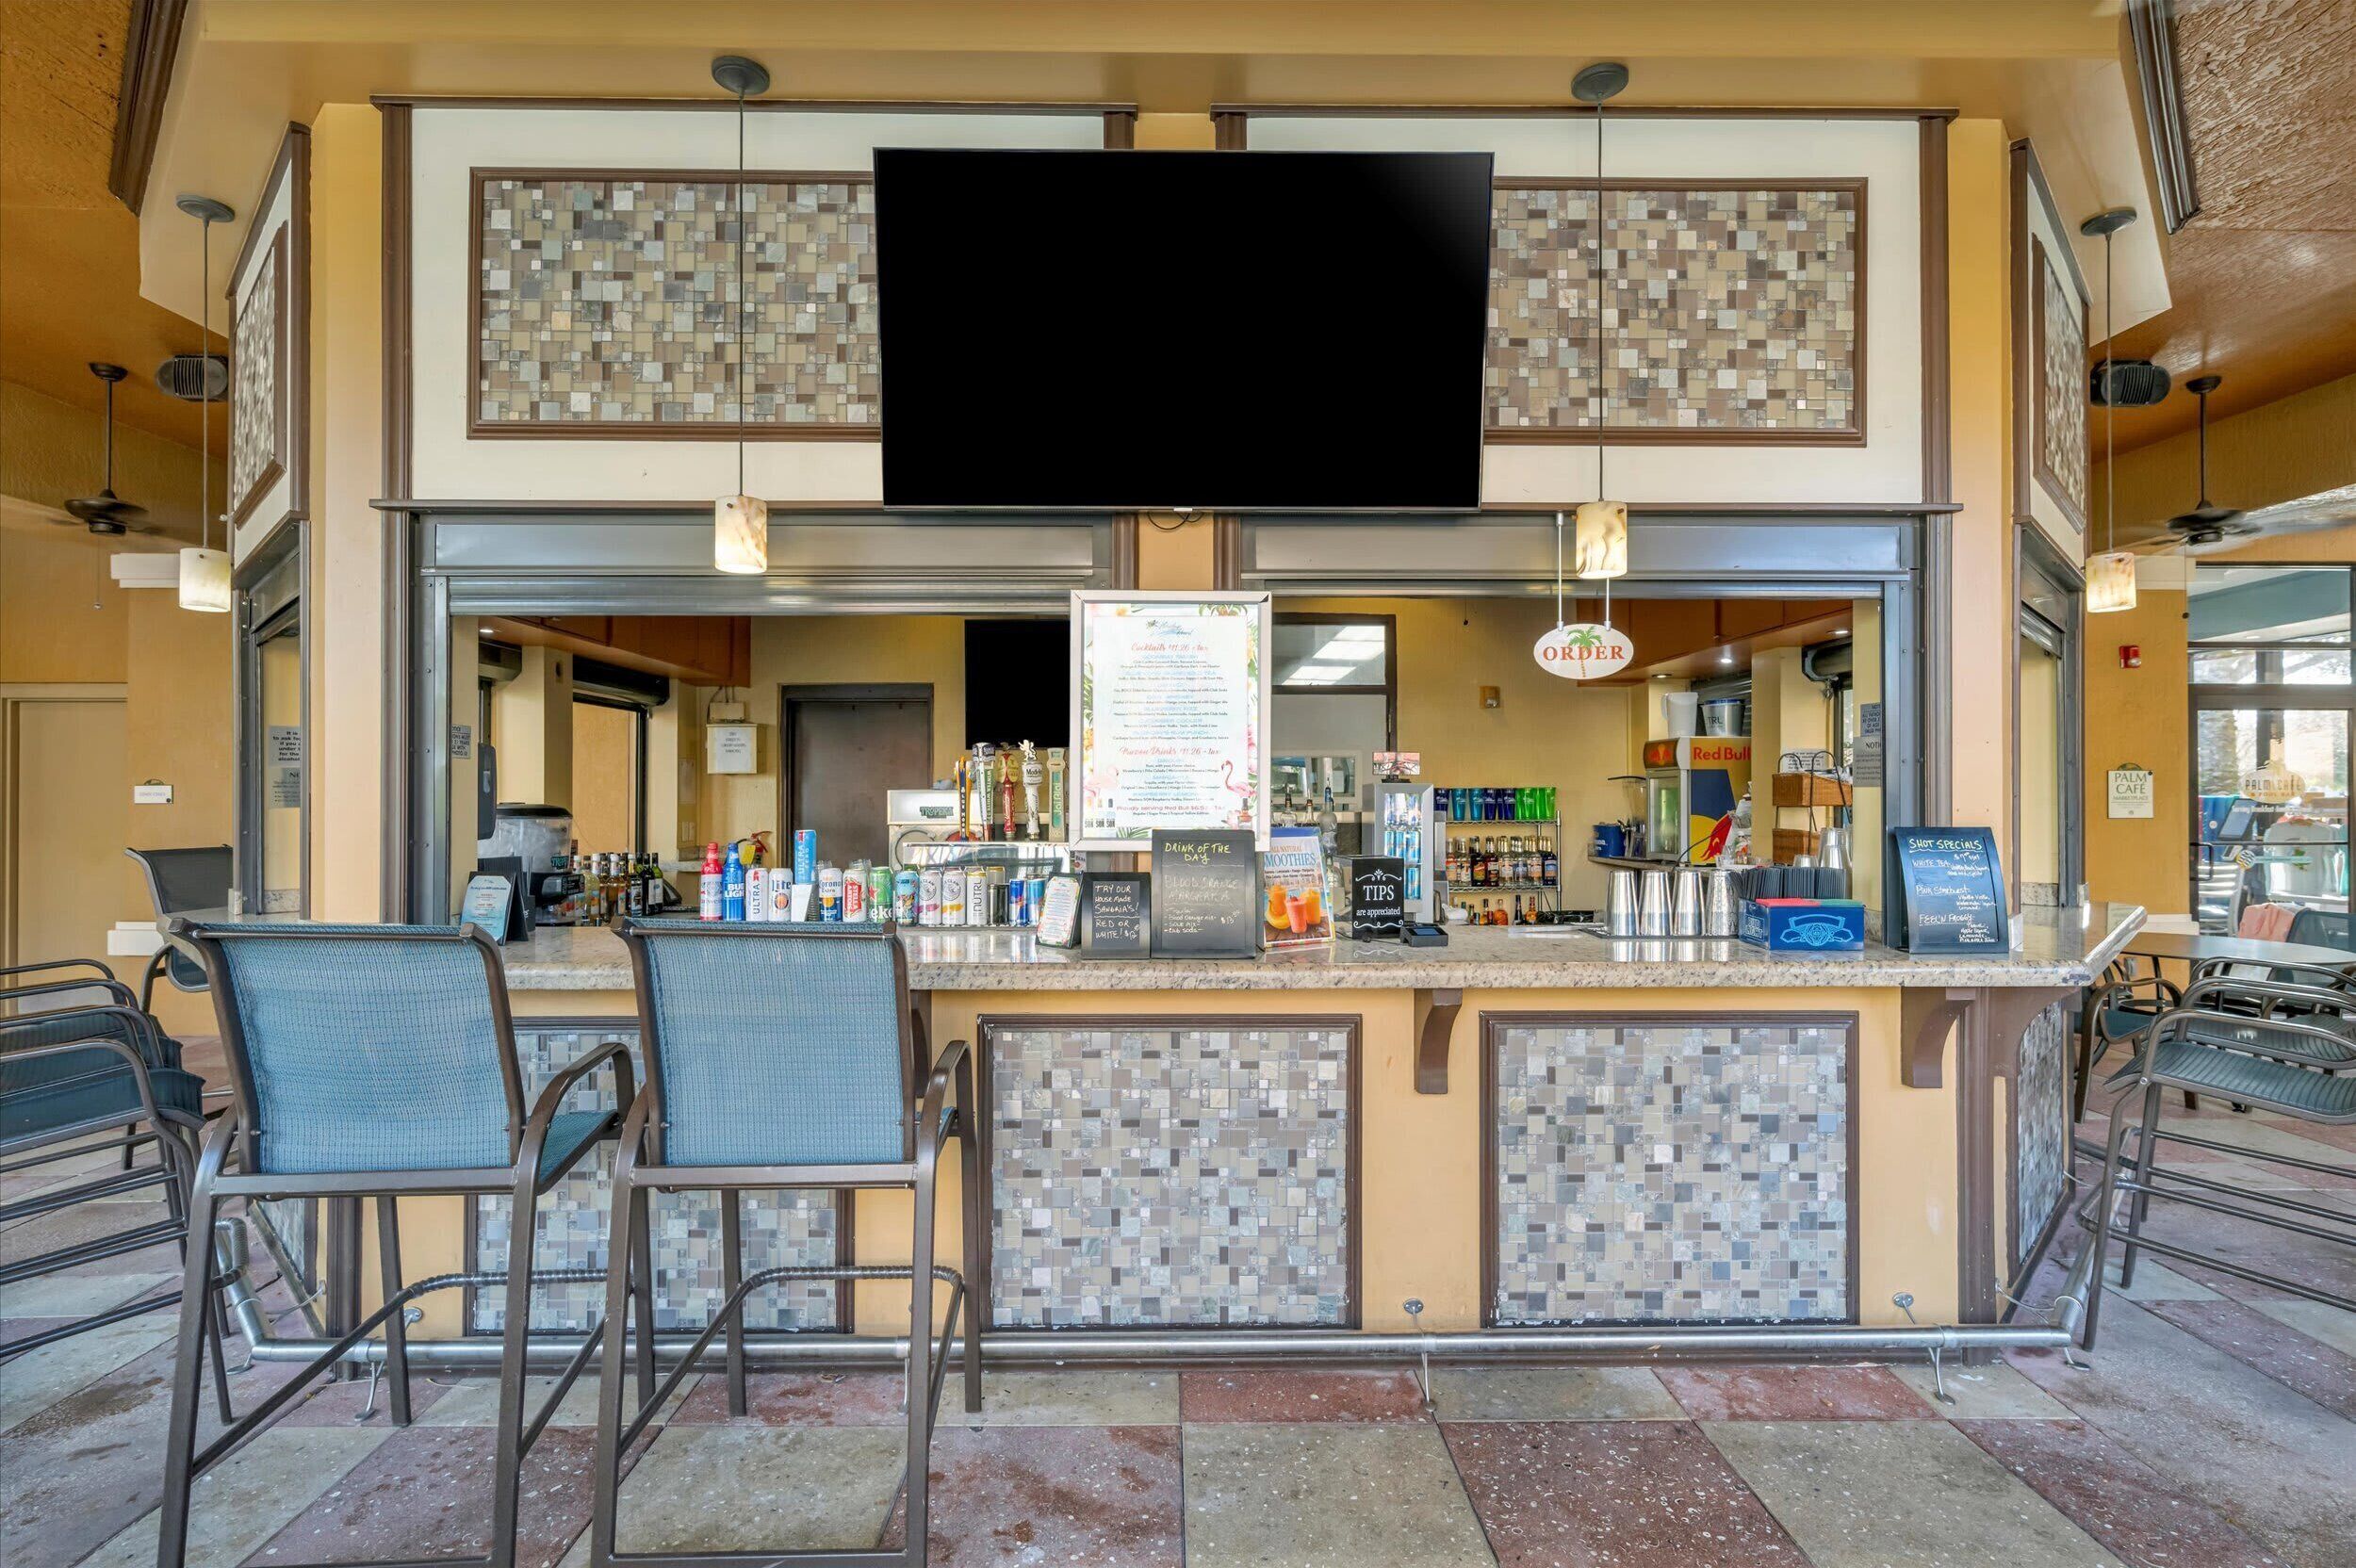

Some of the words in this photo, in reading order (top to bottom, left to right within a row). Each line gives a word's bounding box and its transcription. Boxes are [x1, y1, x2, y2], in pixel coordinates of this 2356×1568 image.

[1543, 645, 1625, 661] ORDER
[1693, 746, 1721, 760] Red
[1725, 746, 1751, 760] Bull
[2115, 773, 2147, 782] PALM
[2117, 782, 2146, 794] CAFÉ
[2246, 780, 2270, 791] PALM
[1165, 841, 1195, 853] DRINK
[1198, 843, 1210, 853] OF
[1211, 843, 1232, 854] THE
[1909, 839, 1934, 849] SHOT
[1184, 853, 1210, 865] DAY
[1912, 858, 1934, 867] WHITE
[1095, 884, 1114, 893] TRY
[1116, 885, 1132, 893] OUR
[1363, 885, 1395, 901] TIPS
[1366, 906, 1400, 918] appreciated
[1096, 919, 1115, 927] RED
